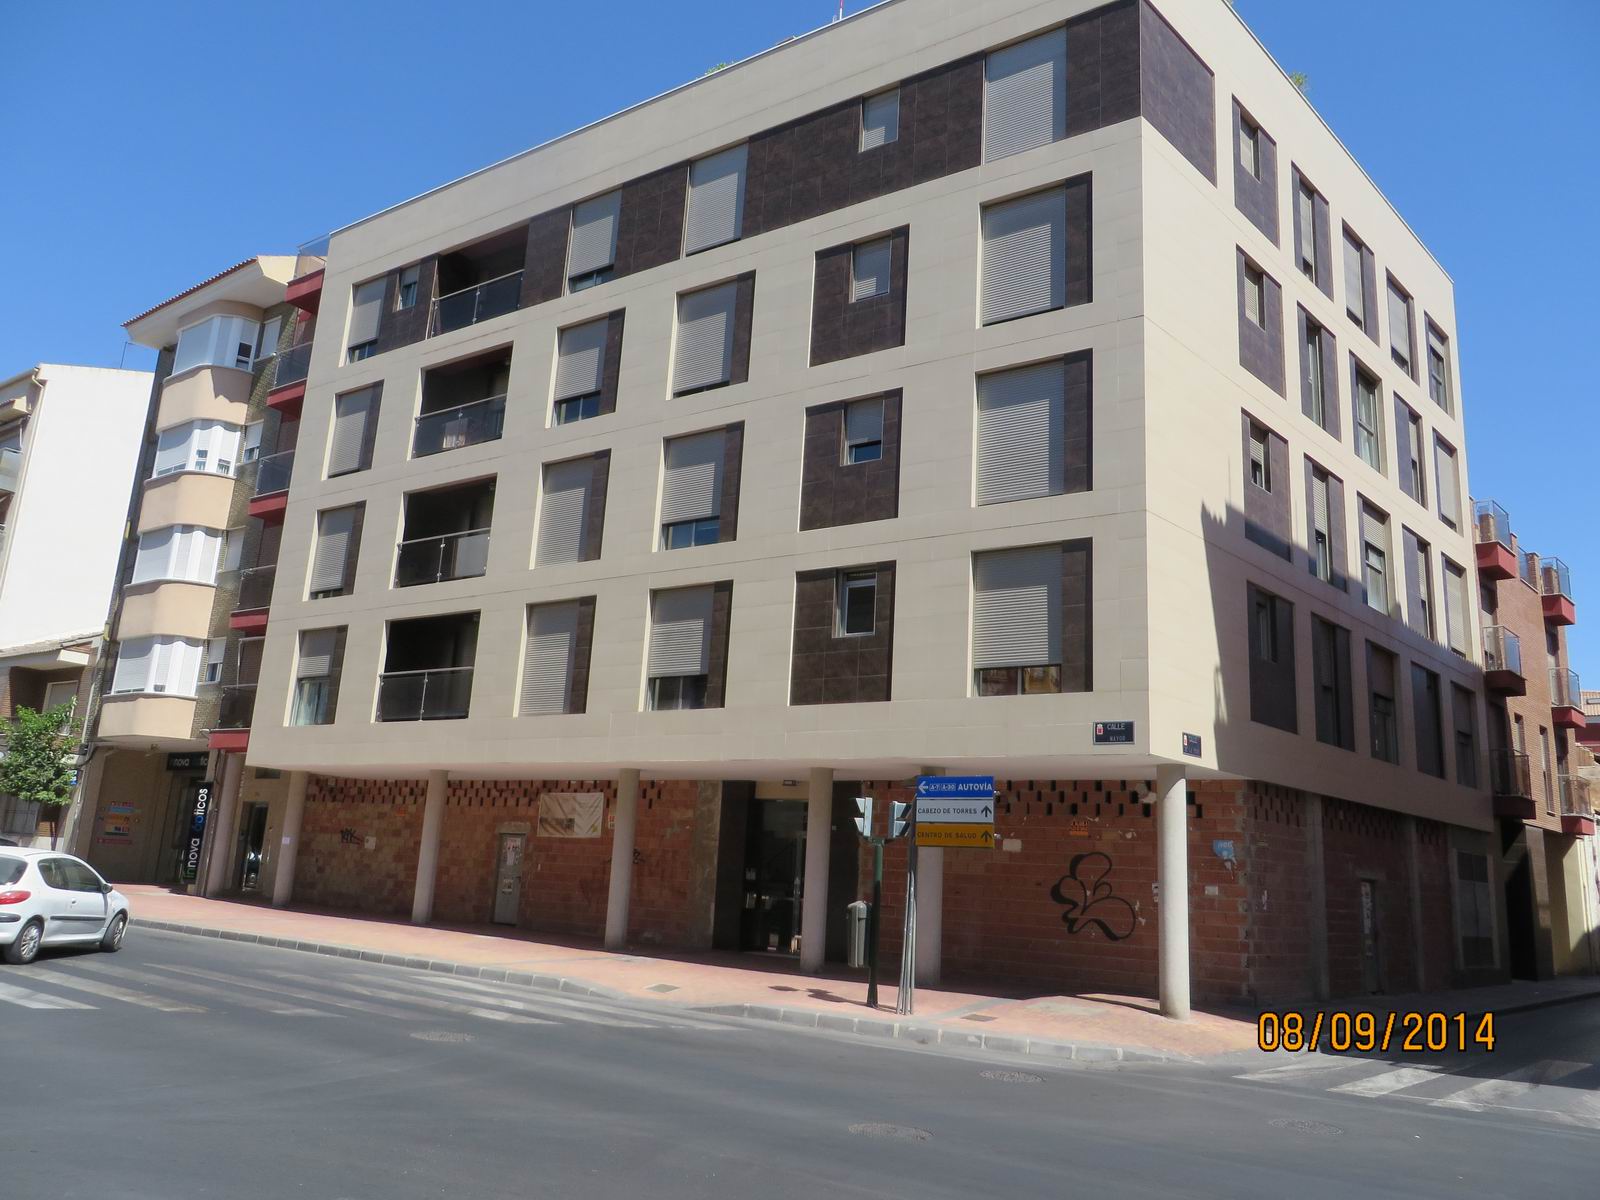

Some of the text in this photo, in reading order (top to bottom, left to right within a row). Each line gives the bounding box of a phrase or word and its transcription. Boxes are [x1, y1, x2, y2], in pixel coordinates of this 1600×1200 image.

[957, 782, 993, 791] AUTOVÍA
[917, 807, 978, 815] CABEZO DE TORRES
[917, 831, 943, 839] CENTRO
[184, 838, 200, 878] innova
